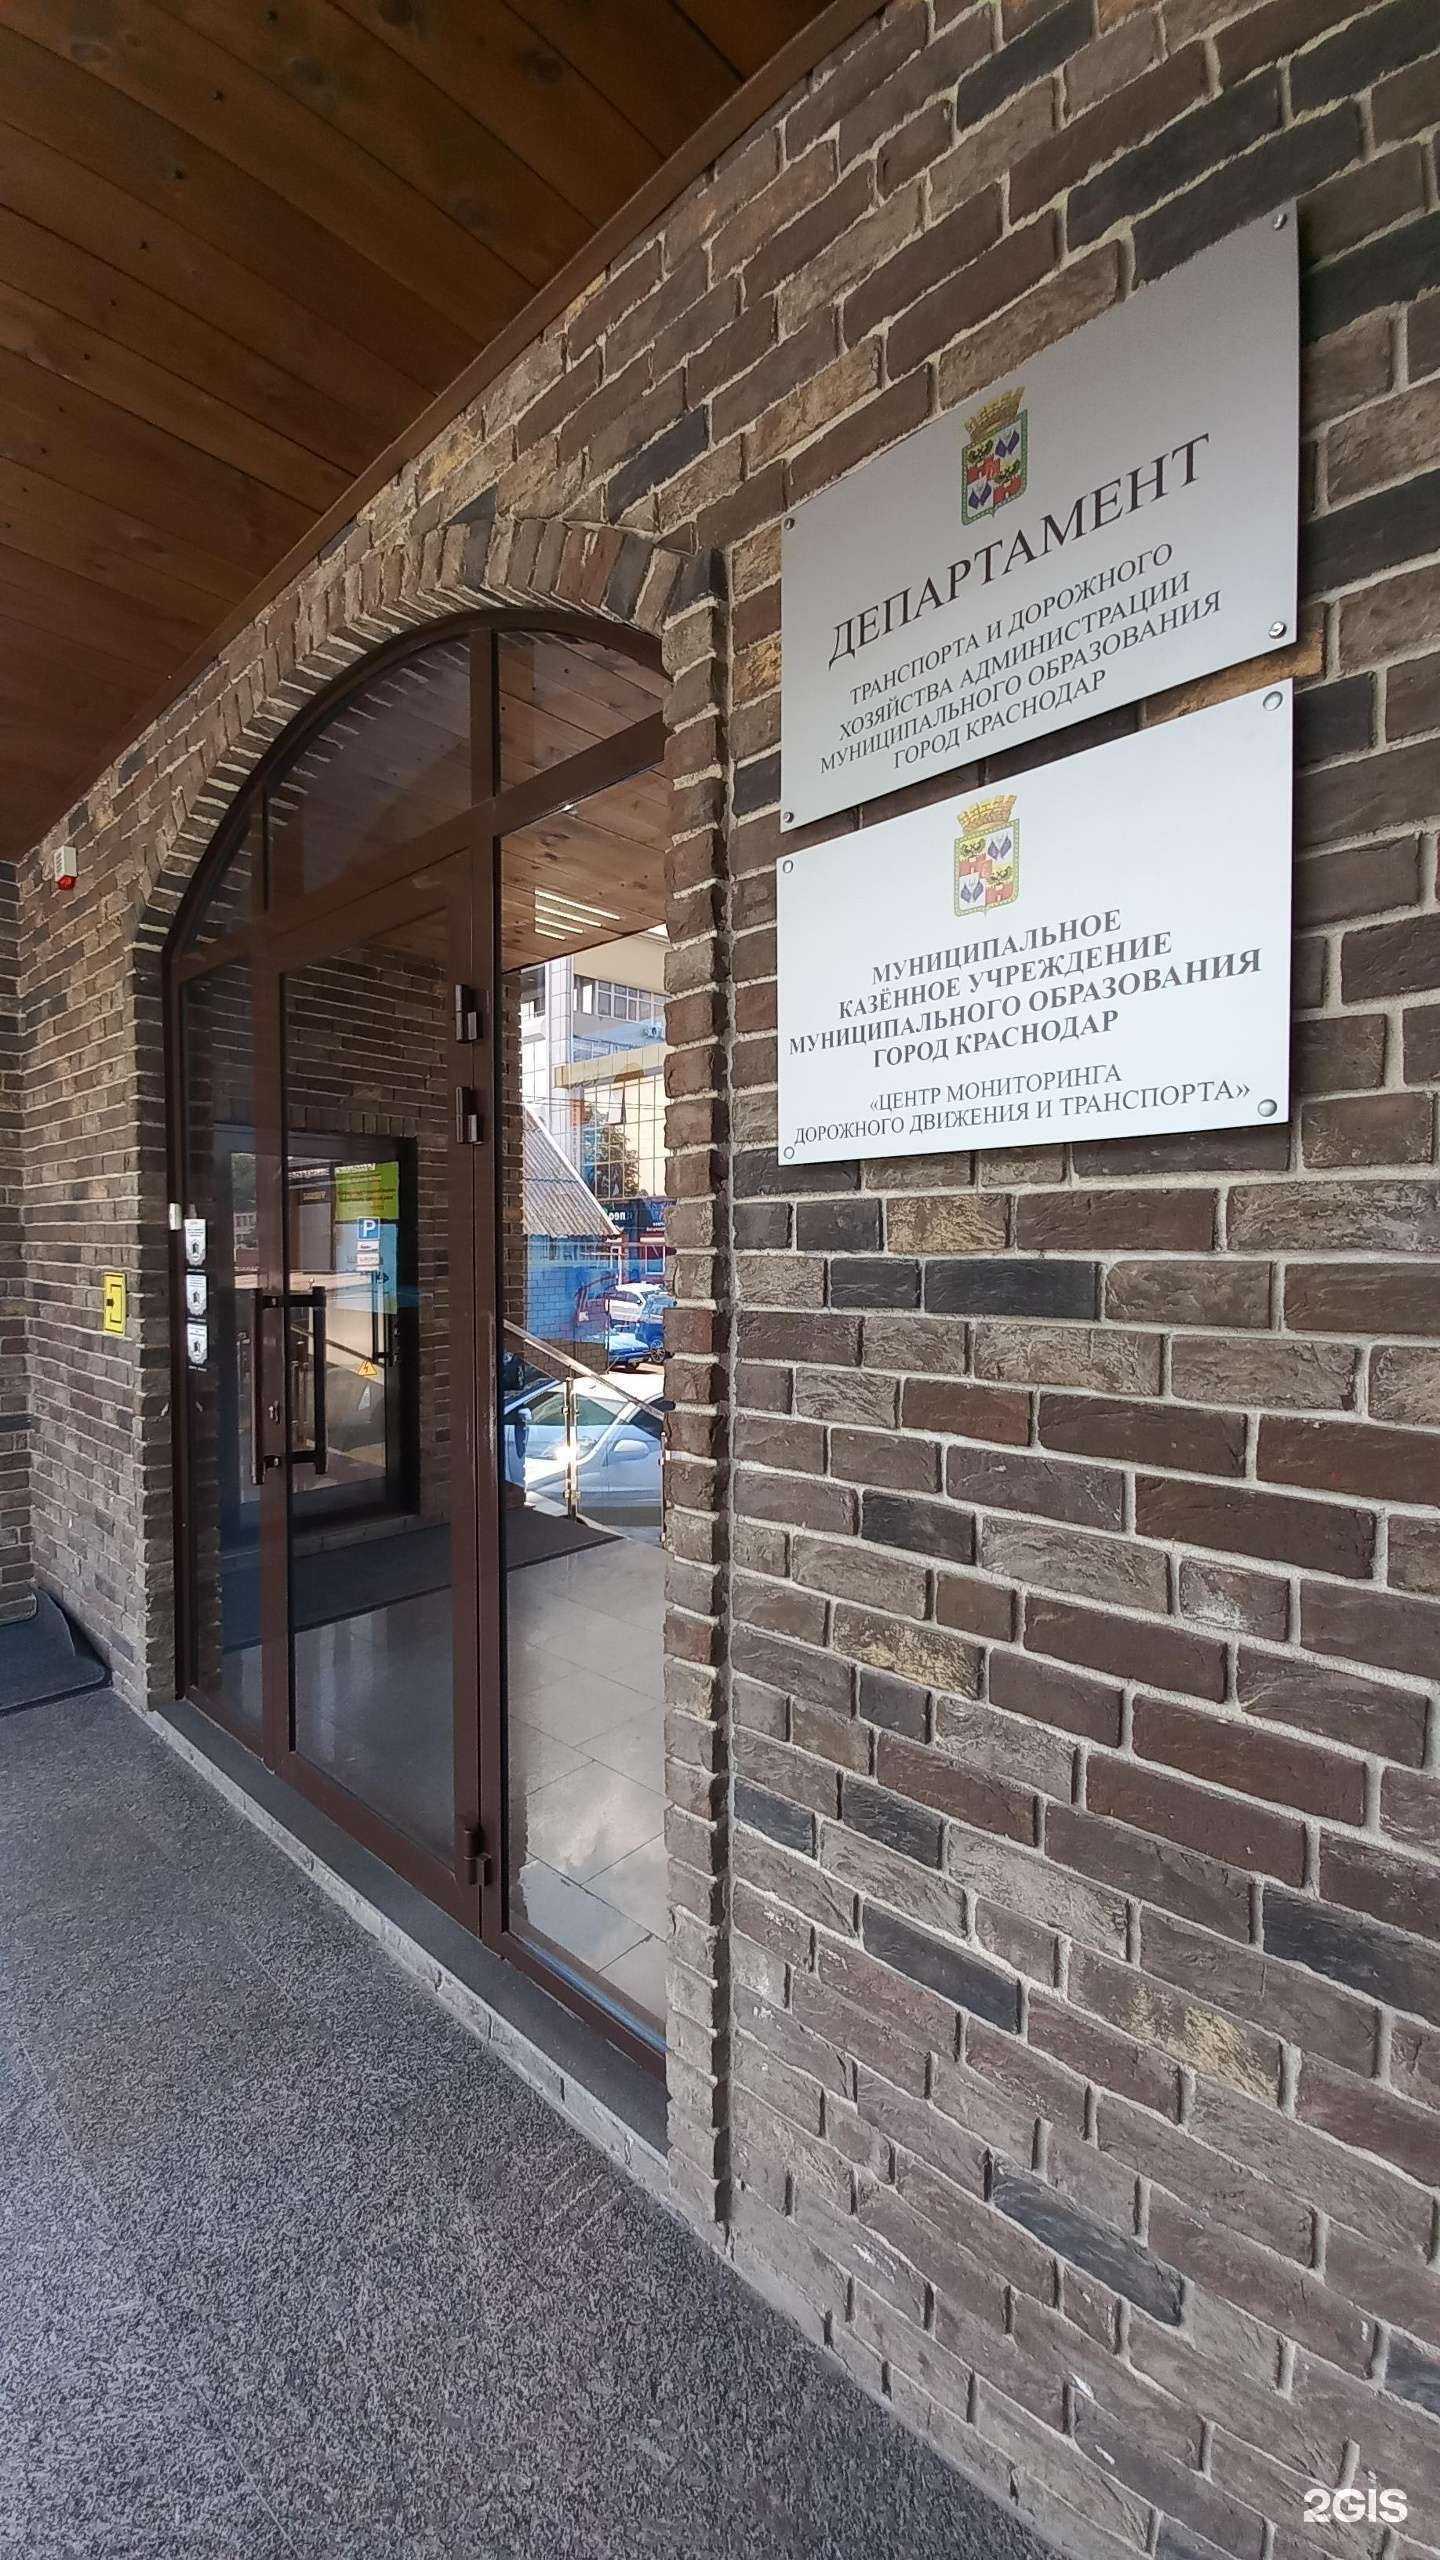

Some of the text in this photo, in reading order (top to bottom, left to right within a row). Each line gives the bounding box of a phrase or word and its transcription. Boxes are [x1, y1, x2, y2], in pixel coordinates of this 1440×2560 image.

[828, 432, 1210, 670] ДЕПАРТАМЕНТ
[839, 570, 1190, 742] ХОЗЯЙСТВА АДМИНИСТРАЦИИ
[849, 543, 1173, 706] ТРАНСПОРТА И ДОРОЖНОГО
[820, 589, 1221, 775] МУНИЦИПАЛЬНОГО ОБРАЗОВАНИЯ
[893, 669, 1106, 769] ГОРОД КРАСНОДАР
[839, 930, 1172, 1020] КАЗЁННОЕ УЧРЕЖДЕНИЕ
[871, 908, 1121, 986] МУНИЦИПАЛЬНОЕ
[789, 947, 1263, 1056] МУНИЦИПАЛЬНОГО ОБРАЗОВАНИЯ
[873, 1009, 1119, 1069] ГОРОД КРАСНОДАР
[793, 1080, 1251, 1147] ДОРОЖНОГО ДВИЖЕНИЯ И ТРАНСПОРТА»
[869, 1063, 1123, 1113] «ЦЕНТР МОНИТОРИНГА
